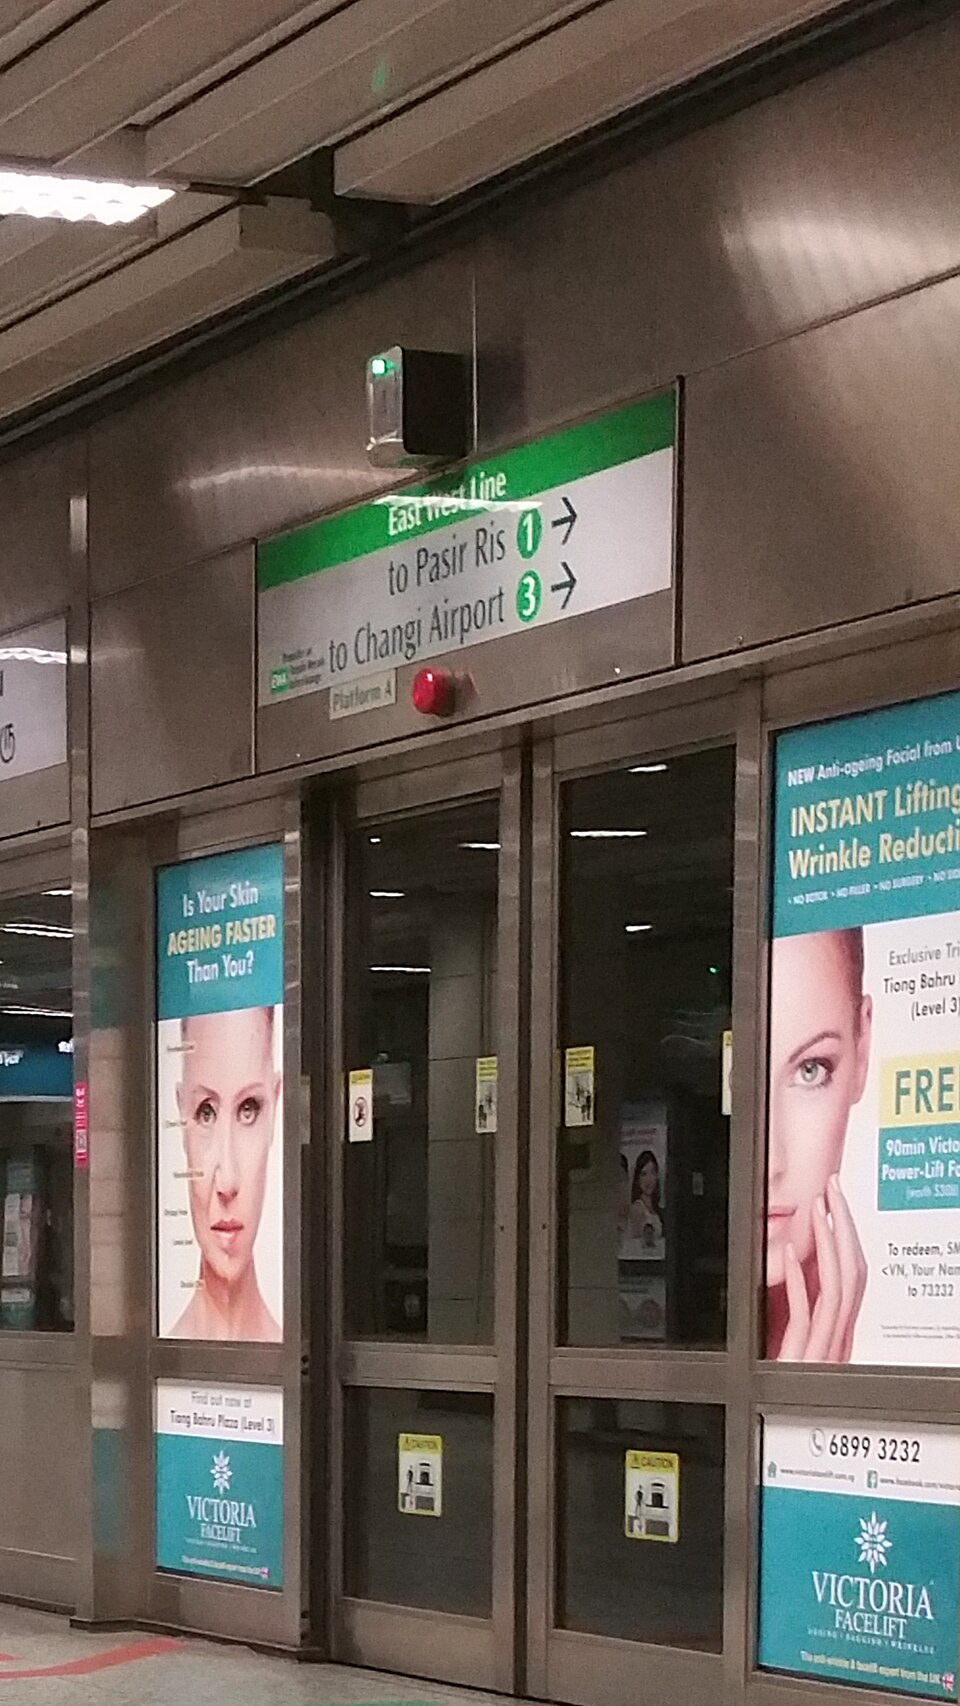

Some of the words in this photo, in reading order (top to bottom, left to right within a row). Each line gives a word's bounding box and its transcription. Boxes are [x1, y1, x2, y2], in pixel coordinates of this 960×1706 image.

[388, 502, 421, 536] East
[470, 471, 507, 502] Line
[388, 561, 408, 596] to
[416, 533, 468, 586] Pasir
[475, 520, 506, 567] Ris
[521, 513, 534, 551] 1
[329, 640, 348, 673] to
[354, 607, 422, 661] Changi
[429, 586, 505, 645] Airport
[521, 576, 536, 617] 3
[787, 766, 815, 787] NEW
[817, 754, 883, 780] Anti-ageing
[887, 743, 921, 766] Facial
[925, 740, 952, 758] from
[791, 789, 888, 837] INSTANT
[894, 778, 960, 817] Lifting
[788, 837, 871, 880] Wrinkle
[183, 893, 194, 918] Is
[197, 889, 226, 914] Your
[229, 881, 259, 908] Skin
[167, 924, 222, 957] AGEING
[226, 914, 277, 945] FASTER
[186, 957, 219, 983] Than
[222, 950, 255, 978] You?
[889, 946, 941, 966] Exclusive
[883, 976, 916, 995] Tiong
[920, 971, 956, 989] Bahru
[911, 997, 945, 1021] (Level
[895, 1066, 958, 1115] FRE
[886, 1137, 925, 1156] 90min
[929, 1136, 960, 1154] Victo
[882, 1160, 944, 1180] Power-Lift
[888, 1243, 899, 1256] To
[902, 1242, 943, 1256] redeem,
[881, 1263, 908, 1277] <VN,
[911, 1263, 935, 1276] Your
[907, 1285, 918, 1297] to
[921, 1283, 954, 1297] 73232
[210, 1394, 223, 1406] out
[244, 1397, 252, 1408] at
[170, 1409, 191, 1428] Tiong
[193, 1411, 216, 1427] Bahru
[218, 1414, 238, 1429] Plaza
[241, 1416, 265, 1433] (Level
[267, 1418, 275, 1434] 3)
[641, 1456, 675, 1469] CAUTION
[829, 1434, 871, 1459] 6899
[877, 1438, 921, 1463] 3232
[185, 1495, 257, 1528] VICTORIA
[200, 1523, 242, 1543] FACELIFT
[812, 1571, 934, 1620] VICTORIA
[835, 1608, 907, 1639] FACELIFT
